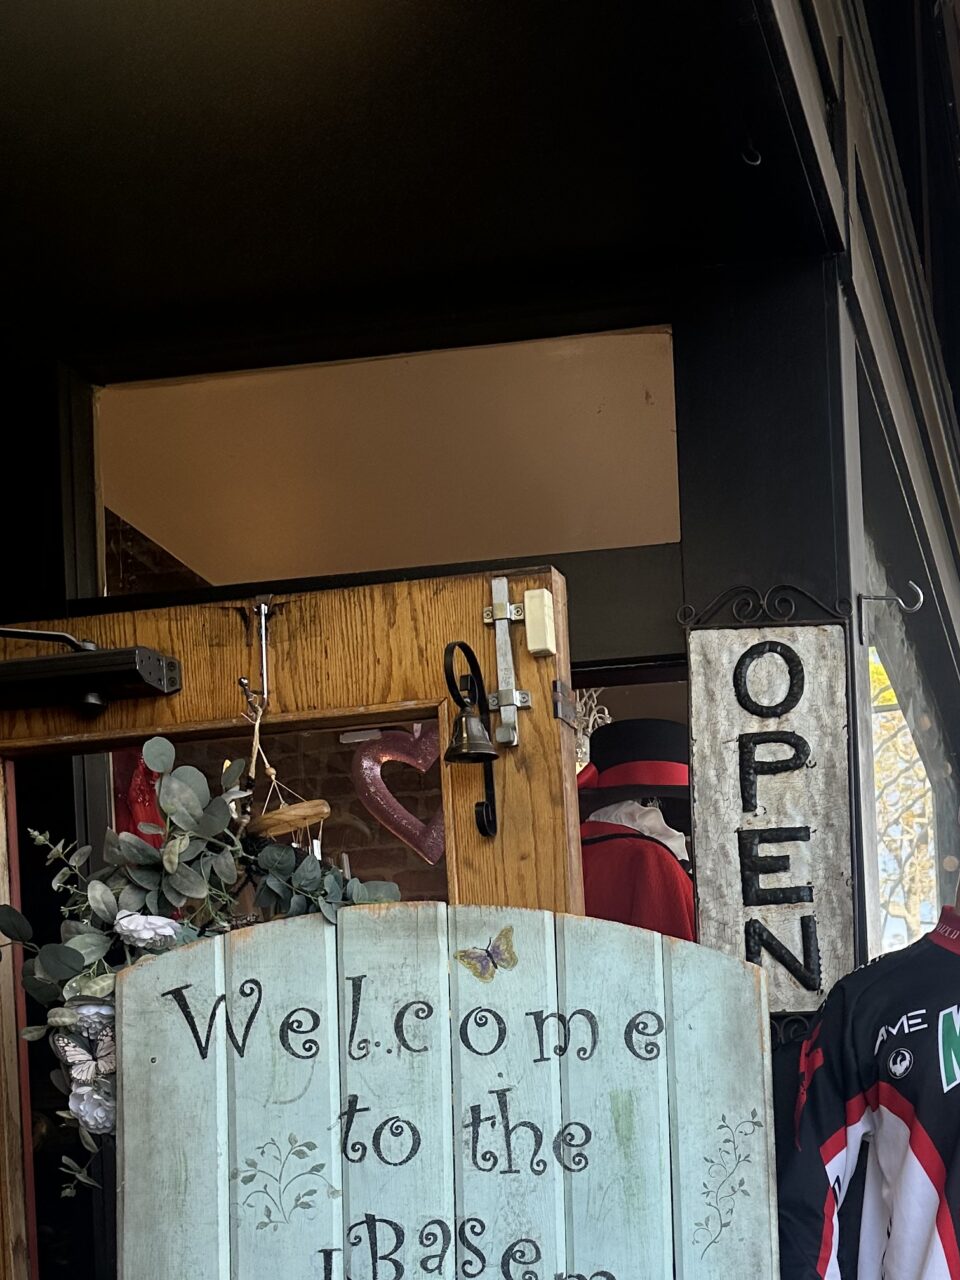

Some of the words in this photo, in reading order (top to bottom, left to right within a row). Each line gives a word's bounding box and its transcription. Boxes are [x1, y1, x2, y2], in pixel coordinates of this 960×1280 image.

[733, 640, 822, 992] OPEN
[163, 975, 664, 1063] Welcome
[338, 1095, 420, 1167] to
[463, 1088, 592, 1175] the
